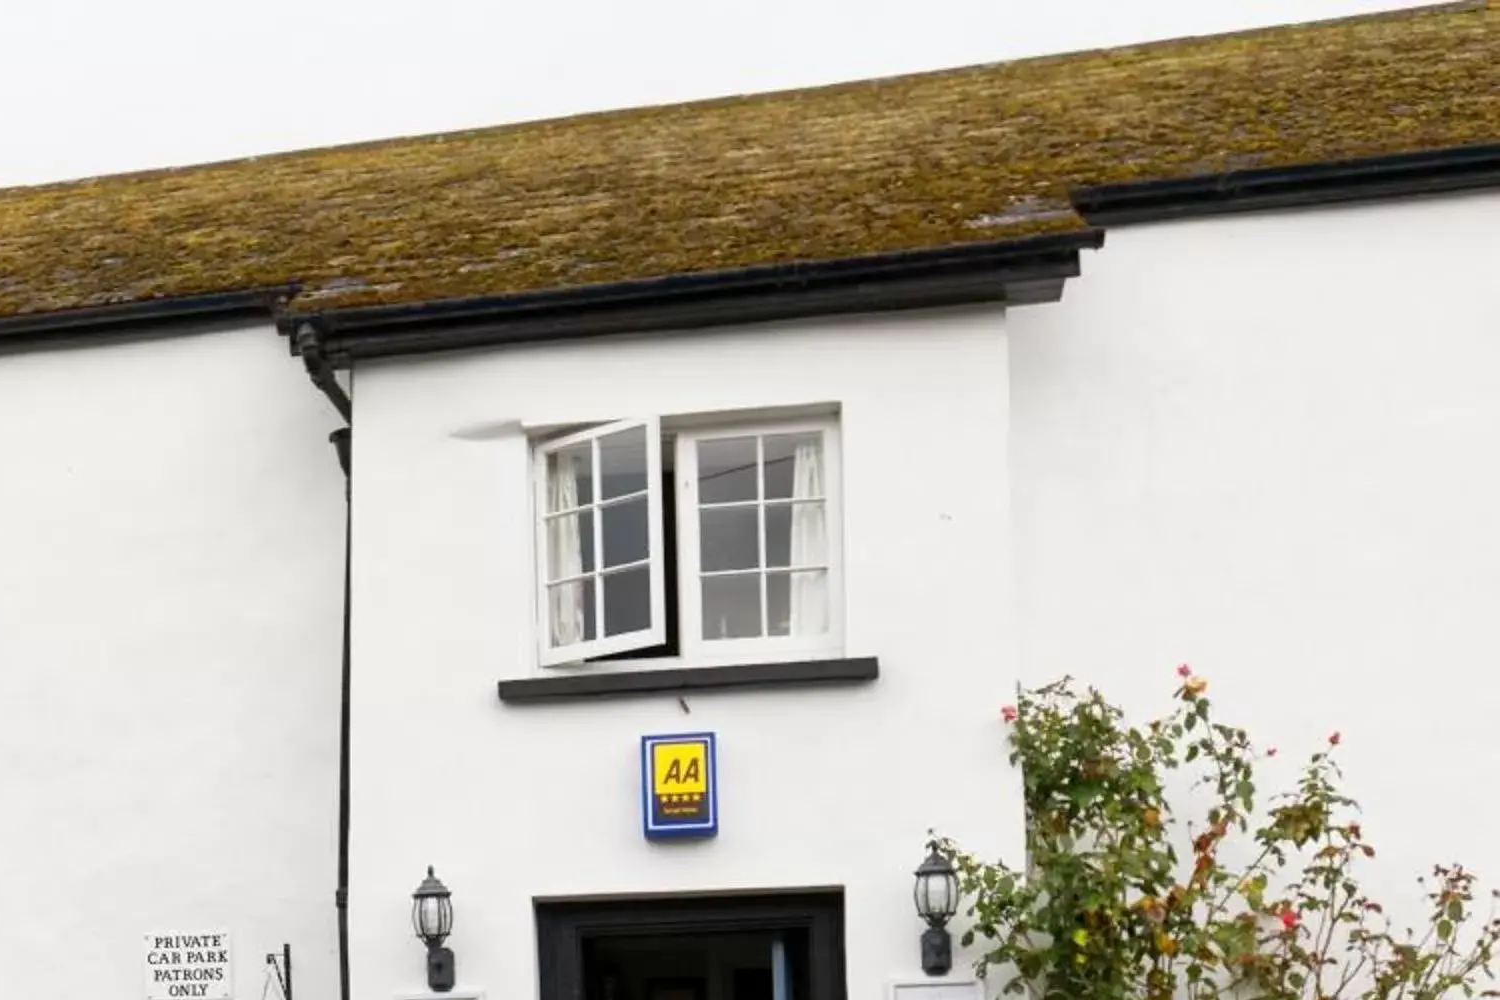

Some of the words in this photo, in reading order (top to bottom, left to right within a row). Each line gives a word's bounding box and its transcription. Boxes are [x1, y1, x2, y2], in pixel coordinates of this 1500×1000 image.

[663, 757, 700, 785] AA
[154, 935, 221, 949] PRIVATE
[147, 951, 181, 965] CAR
[186, 950, 229, 963] PARK
[153, 967, 224, 982] PATRONS
[168, 983, 208, 997] ONLY
